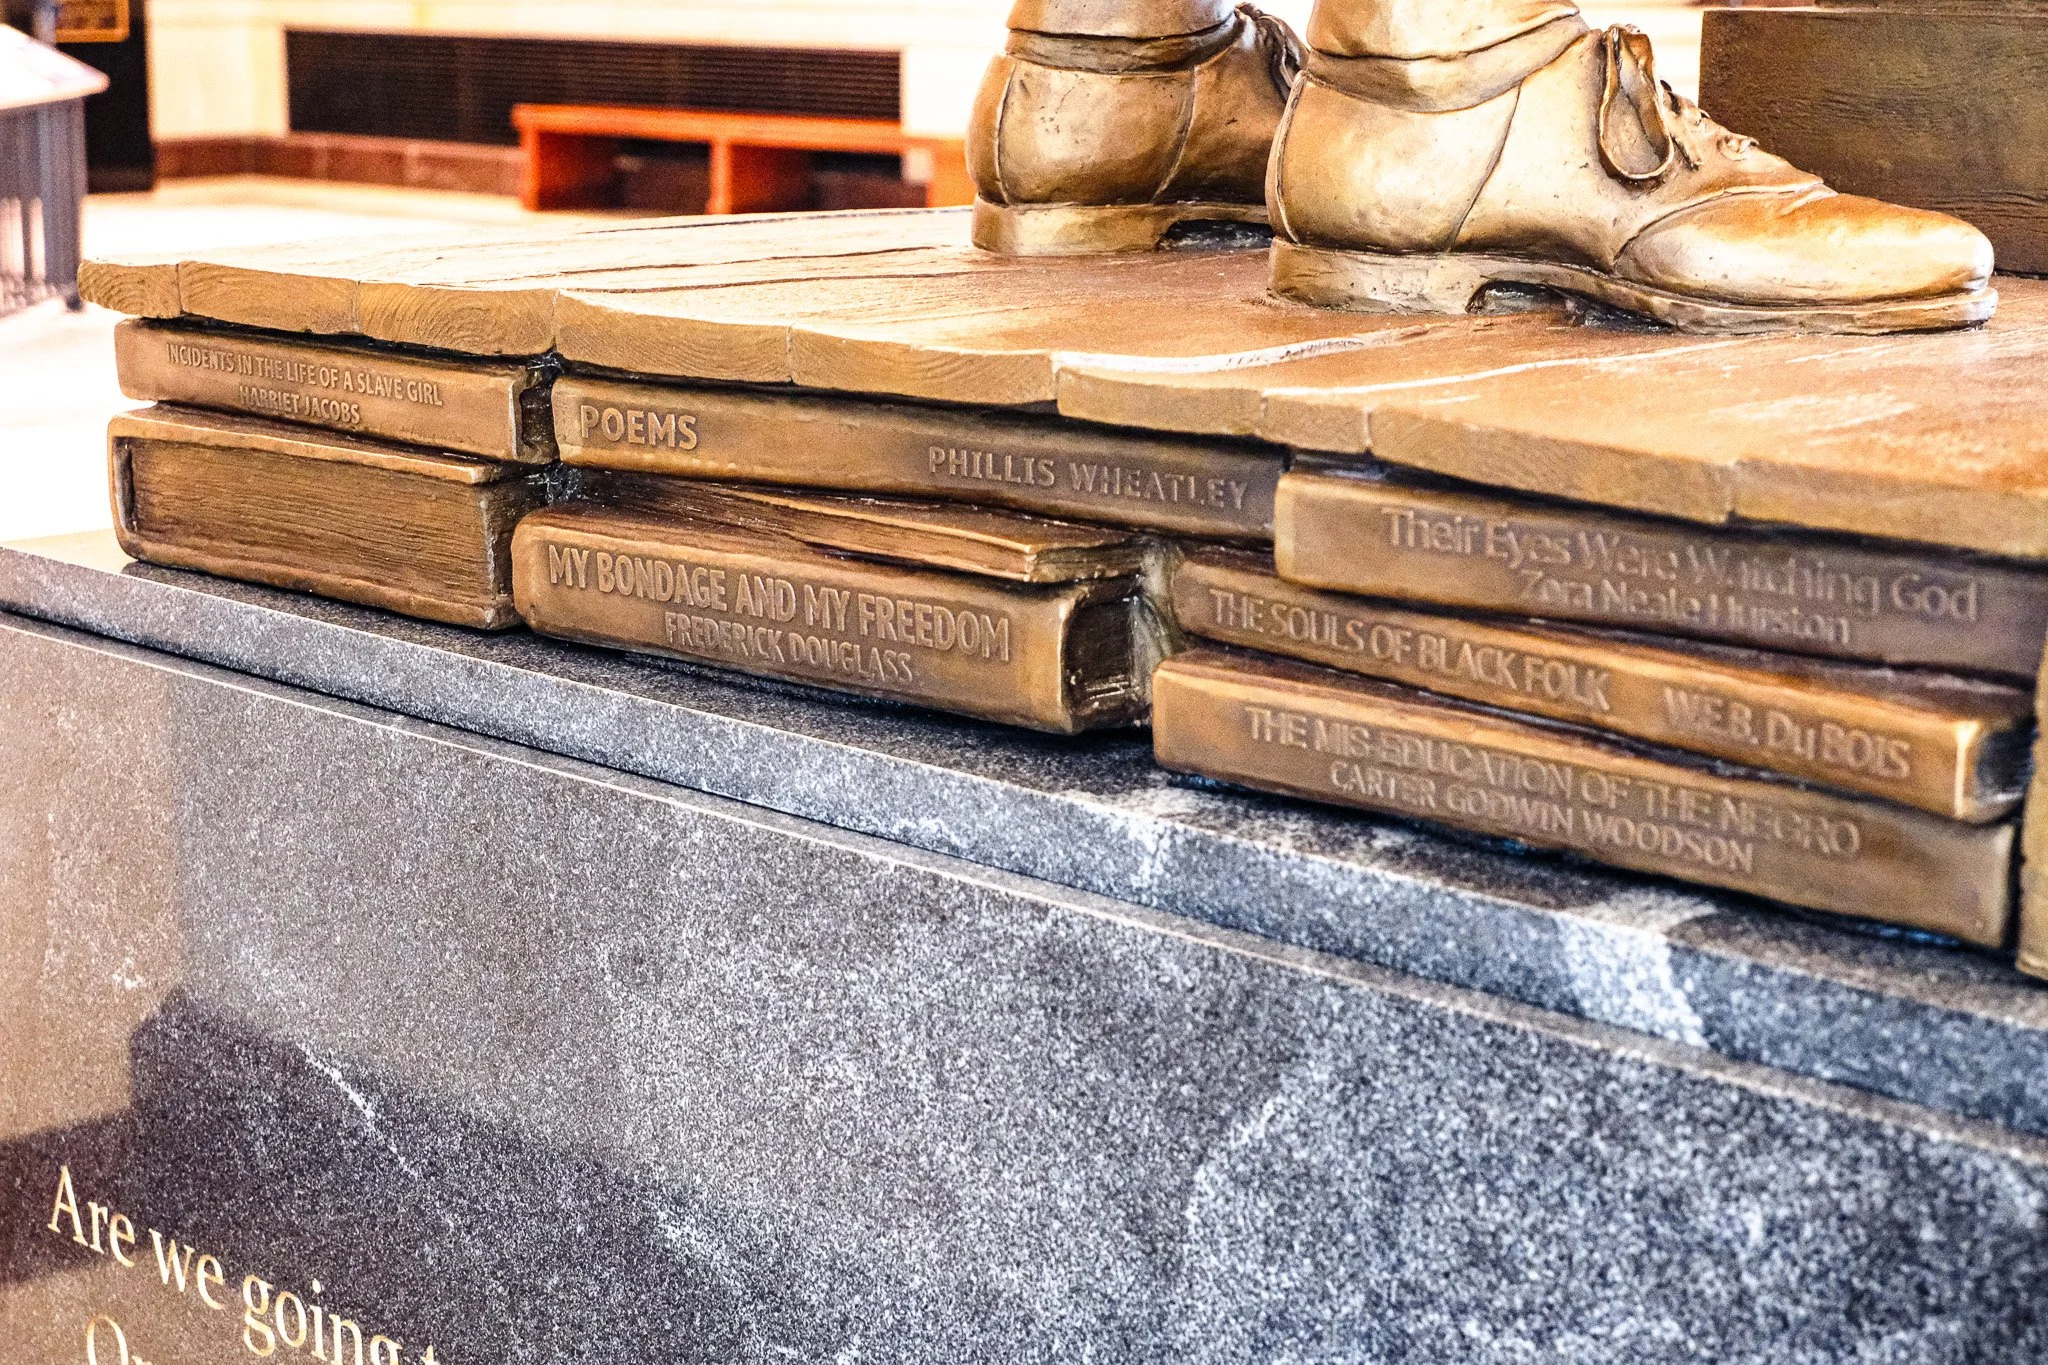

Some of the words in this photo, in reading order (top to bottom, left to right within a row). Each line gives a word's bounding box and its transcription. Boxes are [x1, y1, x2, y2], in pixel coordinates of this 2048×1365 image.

[166, 343, 235, 373] INCIDENTS
[238, 353, 252, 375] IN
[253, 357, 284, 380] THE
[286, 362, 316, 386] LIFE
[319, 368, 339, 390] OF
[343, 370, 354, 390] A
[357, 373, 403, 400] SLAVE
[408, 380, 443, 406] GIRL
[239, 385, 300, 414] HARRIET
[303, 395, 360, 424] JACOBS
[580, 404, 698, 450] POEMS
[928, 446, 1055, 487] PHILLIS
[1069, 461, 1248, 511] WHEATLEY
[548, 544, 589, 589] MY
[597, 551, 727, 612] BONDAGE
[735, 573, 796, 622] AND
[804, 584, 850, 632] MY
[858, 593, 1009, 662] FREEDOM
[1381, 507, 1479, 555] Their
[1486, 518, 1571, 570] Eyes
[1891, 572, 1977, 622] God
[1519, 569, 1593, 610] Zora
[664, 611, 785, 663] FREDERICK
[789, 632, 913, 682] DOUGLASS
[1210, 589, 1265, 632] THE
[1270, 603, 1366, 653] SOULS
[1370, 623, 1410, 665] OF
[1417, 636, 1518, 691] BLACK
[1523, 657, 1610, 713] FOLK
[1245, 705, 1308, 750] THE
[1580, 771, 1631, 809] OF
[1637, 779, 1711, 828] THE
[1719, 797, 1861, 856] NEGRO
[1331, 759, 1436, 810] CARTER
[1445, 781, 1574, 837] GODWIN
[1582, 809, 1752, 873] WOODSON
[47, 1164, 136, 1268] Are
[148, 1227, 226, 1311] we
